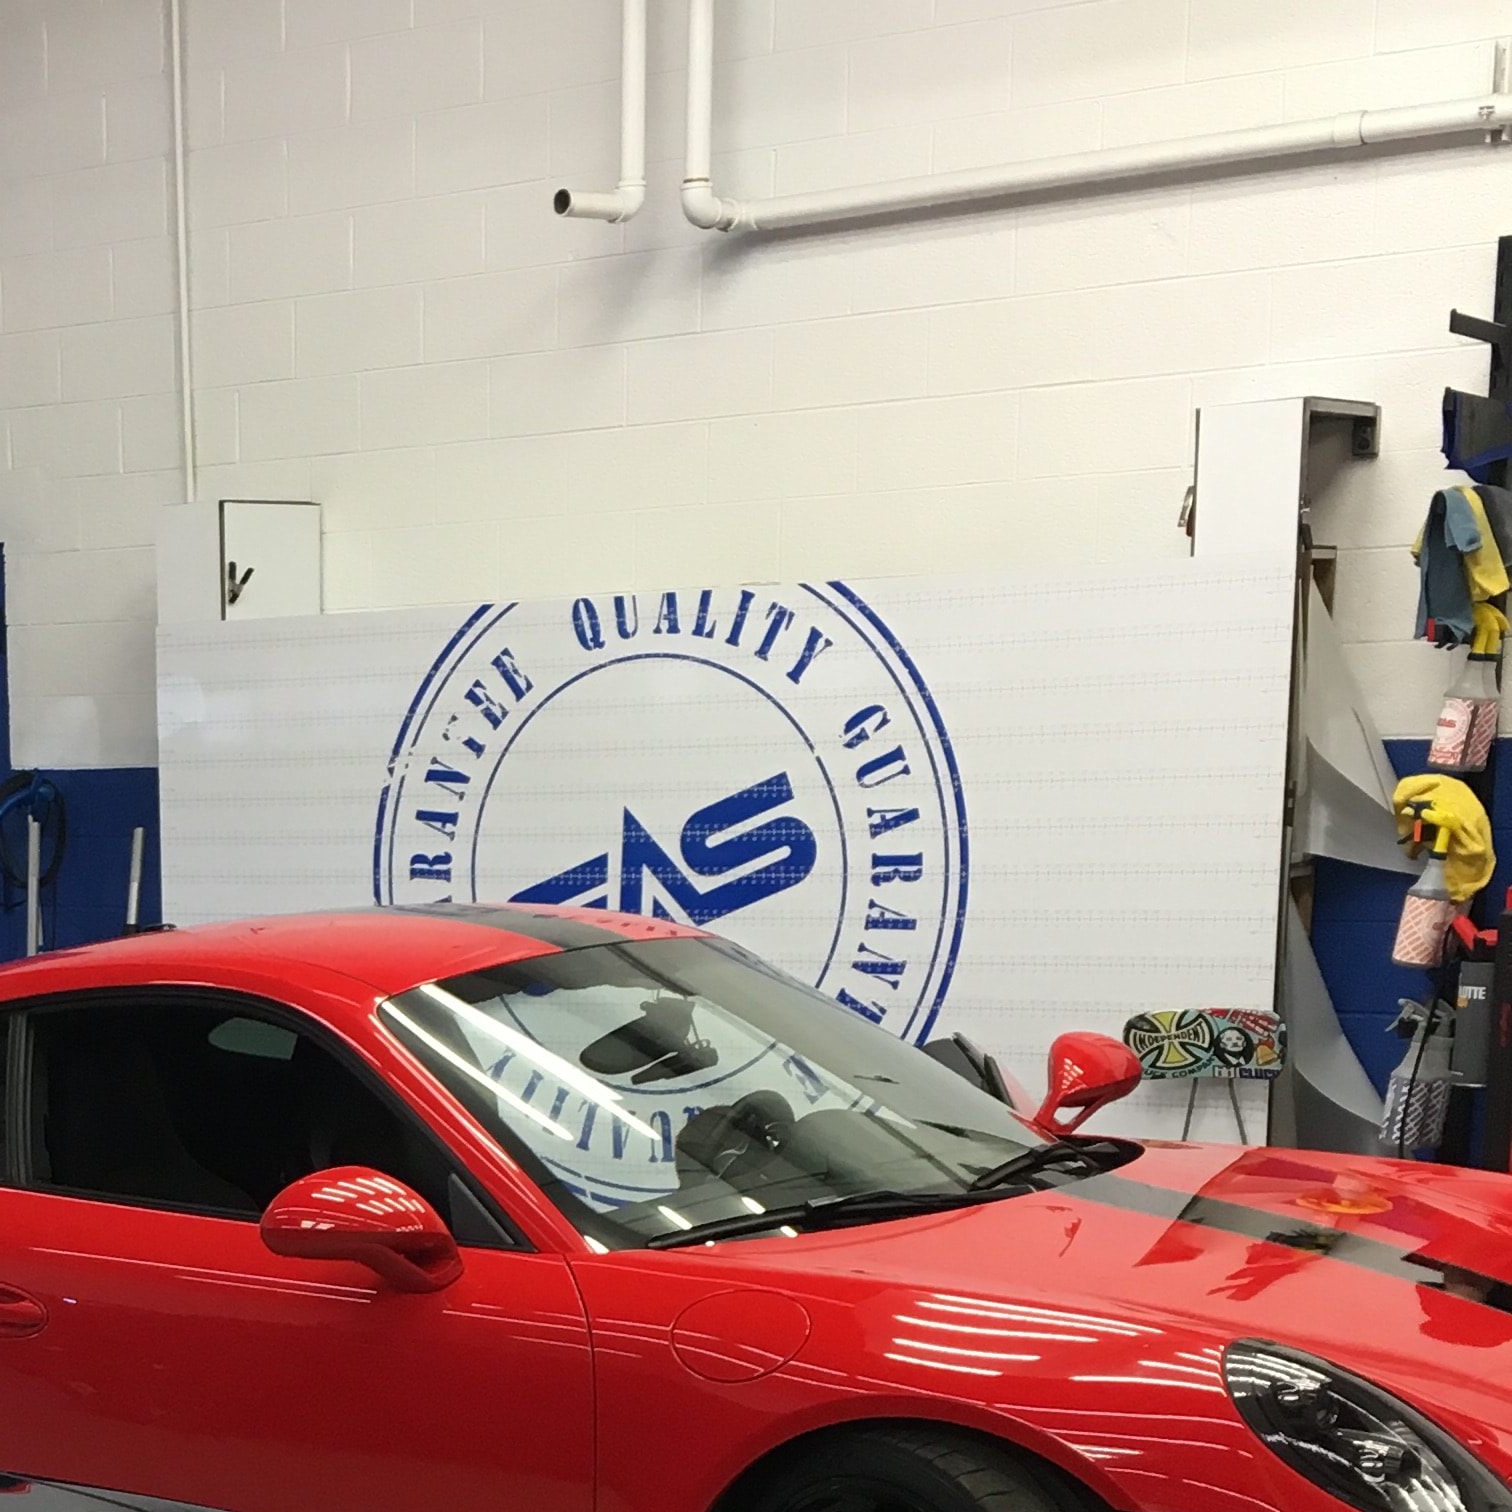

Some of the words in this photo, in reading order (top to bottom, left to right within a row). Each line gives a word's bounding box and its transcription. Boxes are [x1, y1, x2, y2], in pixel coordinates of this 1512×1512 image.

[571, 589, 834, 685] QUALITY
[409, 647, 535, 902] RANTEE
[1133, 1018, 1206, 1054] INDEPENDENT
